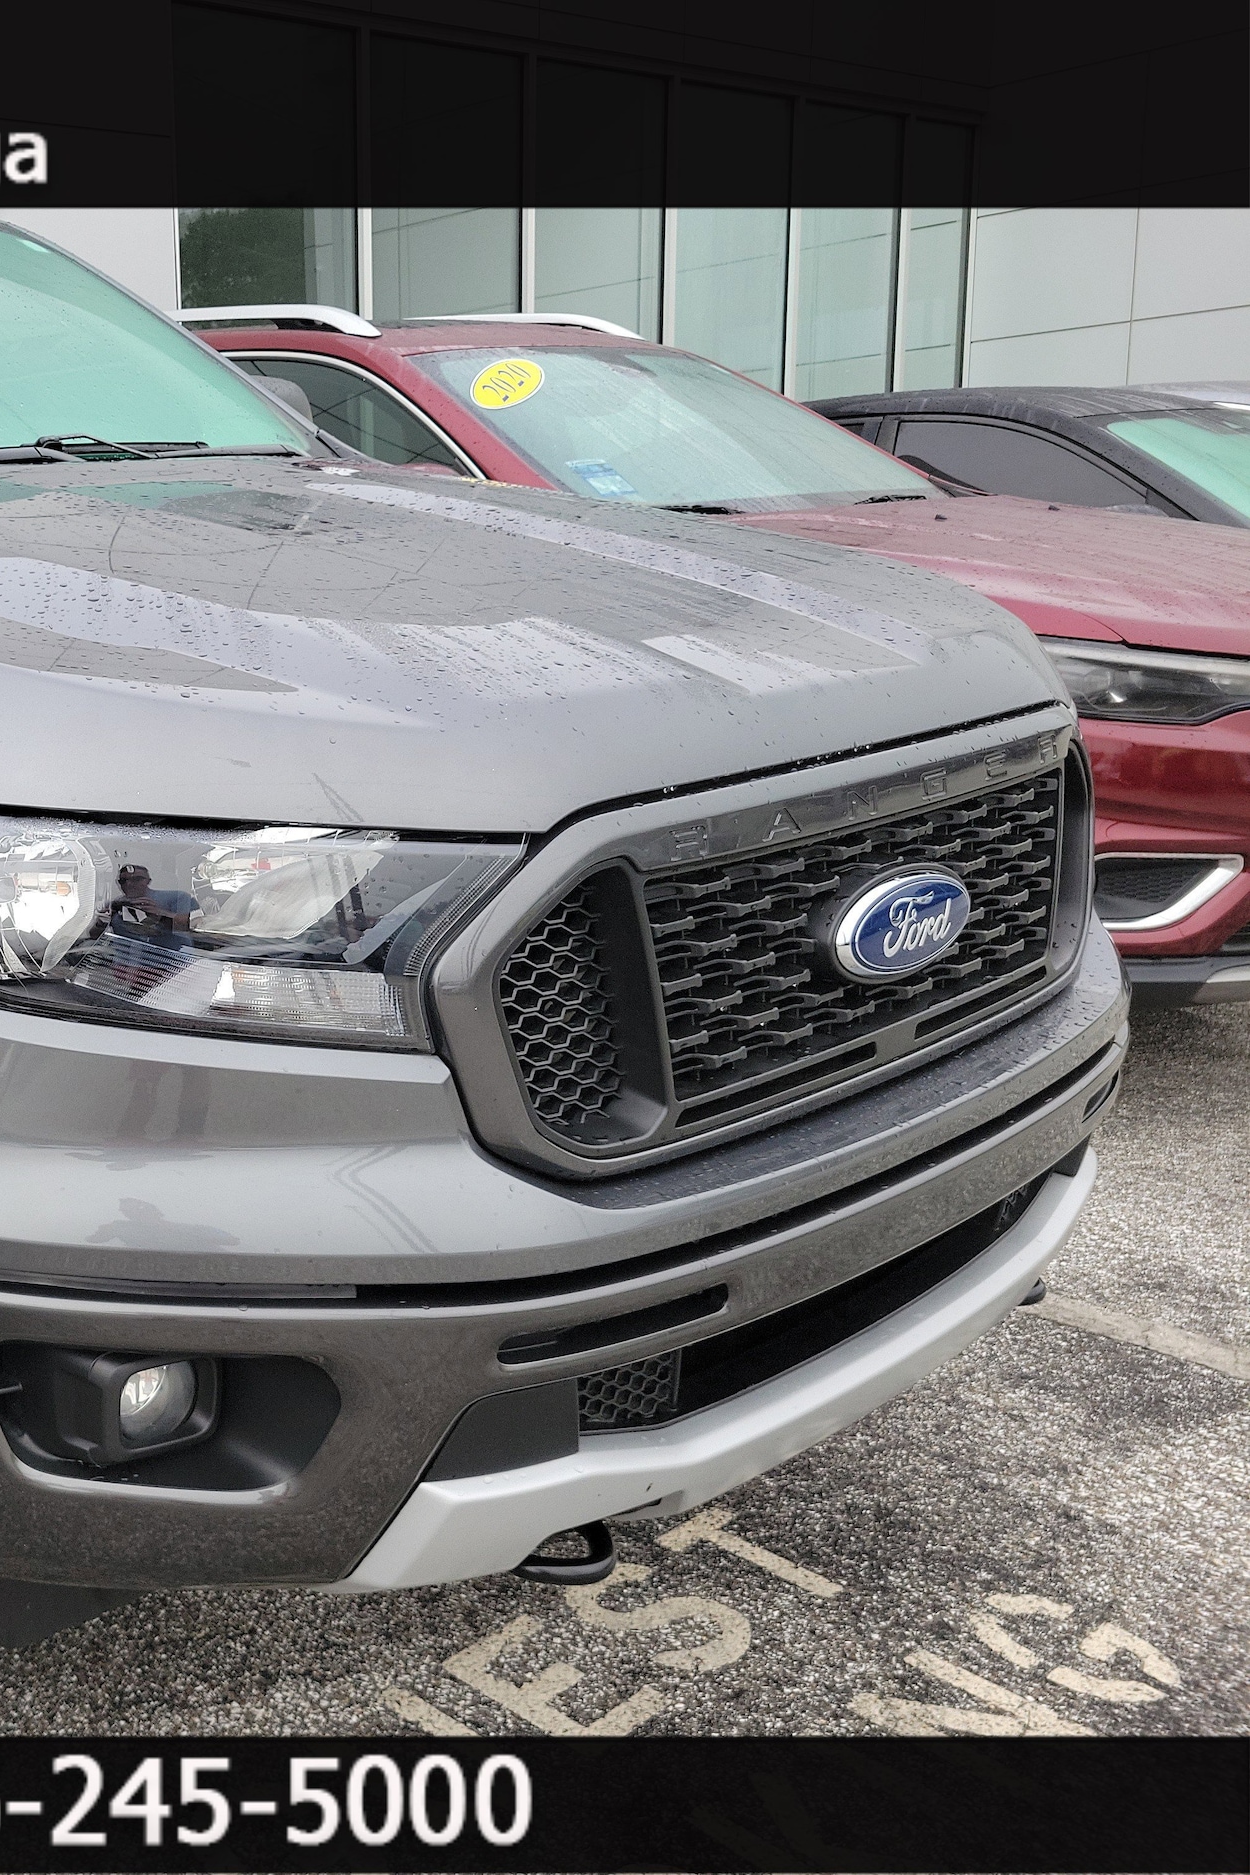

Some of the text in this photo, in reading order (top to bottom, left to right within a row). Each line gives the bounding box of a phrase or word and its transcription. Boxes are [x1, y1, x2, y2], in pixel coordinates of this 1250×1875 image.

[482, 362, 532, 403] 2020
[669, 733, 1058, 862] RANGER
[882, 890, 953, 958] Ford
